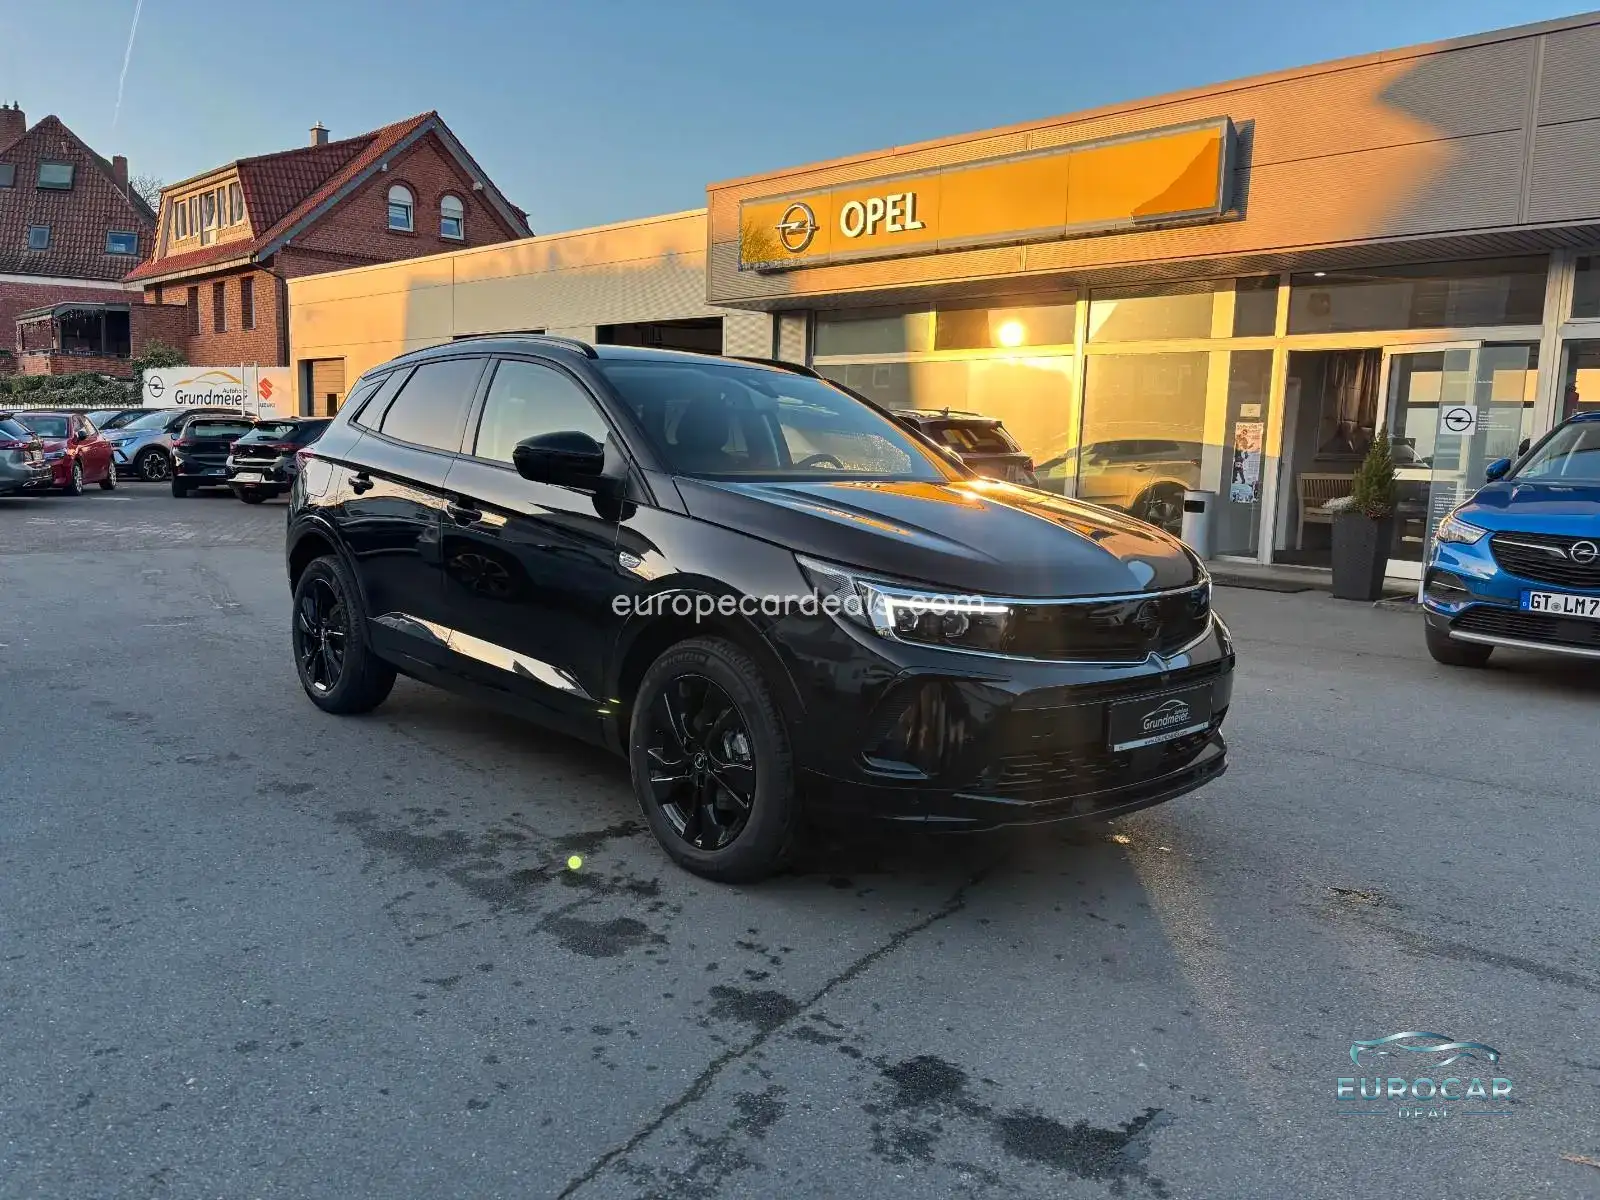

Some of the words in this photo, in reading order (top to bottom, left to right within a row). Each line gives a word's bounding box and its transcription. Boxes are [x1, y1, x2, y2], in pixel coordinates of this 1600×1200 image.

[839, 191, 924, 239] OPEL
[1531, 593, 1552, 611] GT
[1143, 711, 1189, 730] Grundmeier
